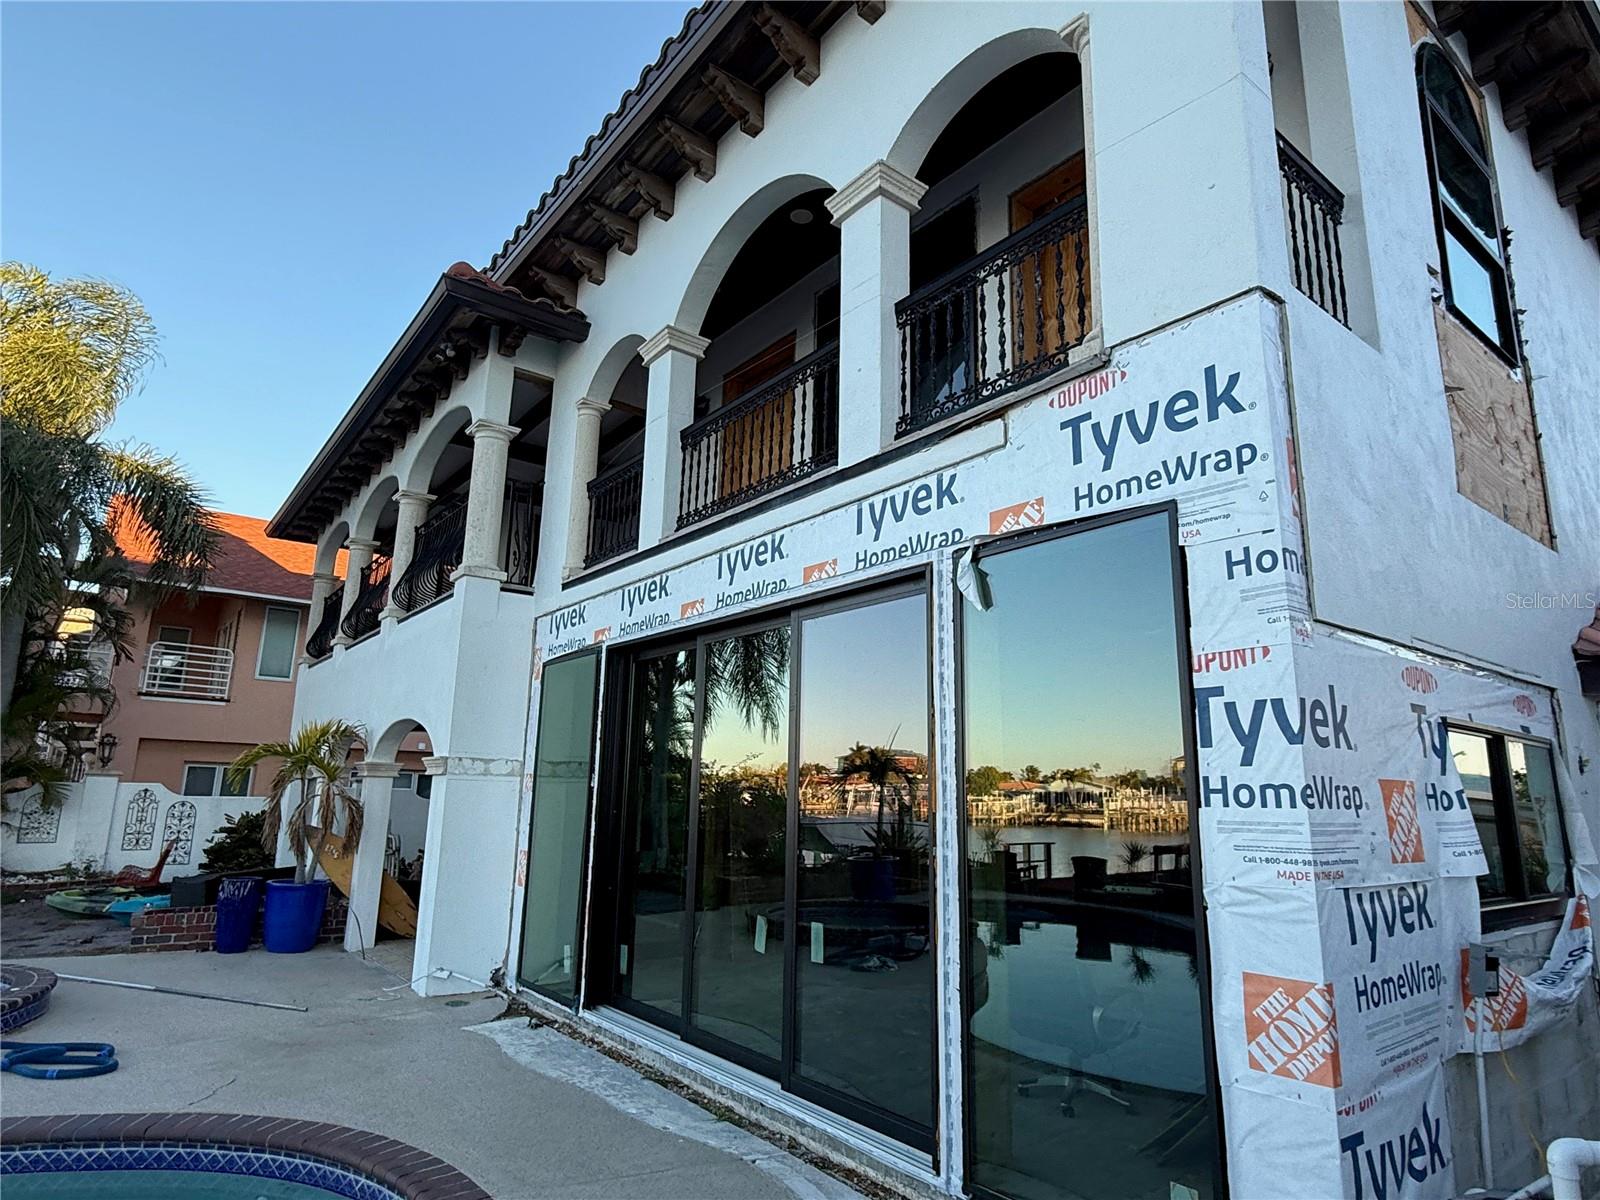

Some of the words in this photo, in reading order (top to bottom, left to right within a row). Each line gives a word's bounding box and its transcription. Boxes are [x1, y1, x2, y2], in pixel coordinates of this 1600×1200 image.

[1057, 370, 1117, 409] DUPONT
[1060, 364, 1247, 472] Tyvek
[1074, 442, 1258, 512] HomeWrap
[856, 473, 960, 542] Tyvek
[718, 533, 784, 586] Tyvek
[855, 528, 964, 570] HomeWrap
[1181, 529, 1201, 540] USA
[1194, 684, 1353, 767] Tyvek
[1202, 775, 1364, 818] HomeWrap
[1243, 855, 1257, 864] Call
[1277, 870, 1312, 881] MADE
[1336, 882, 1434, 963] Tyvek
[1252, 986, 1294, 1024] THE
[1354, 960, 1442, 1014] HomeWrap
[1247, 985, 1334, 1074] HOME
